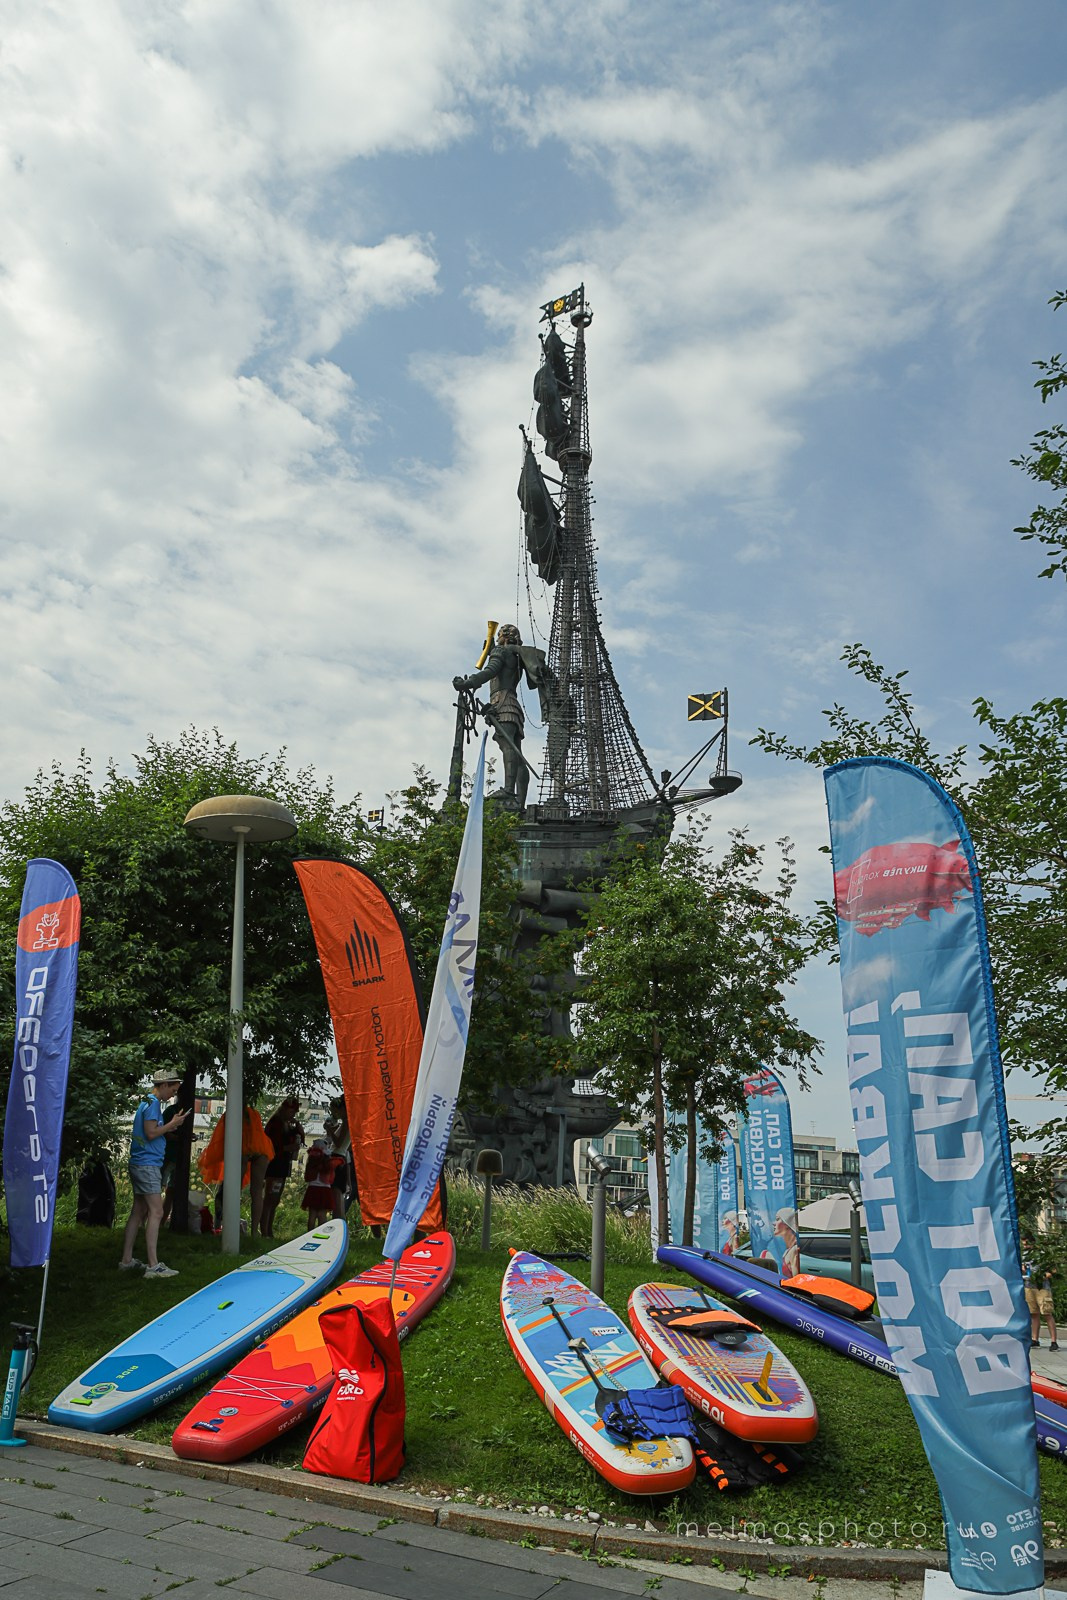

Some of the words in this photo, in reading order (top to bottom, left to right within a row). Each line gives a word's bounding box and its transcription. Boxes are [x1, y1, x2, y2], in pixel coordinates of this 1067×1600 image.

[352, 975, 385, 987] SHARK
[370, 1005, 388, 1057] Motion
[377, 1059, 396, 1121] Forward
[795, 1317, 825, 1339] BASIC
[850, 1345, 875, 1363] FACE
[115, 1365, 139, 1380] RIDE
[876, 1359, 898, 1374] SUP
[192, 1369, 209, 1385] RIDE
[3, 1394, 12, 1416] FACE
